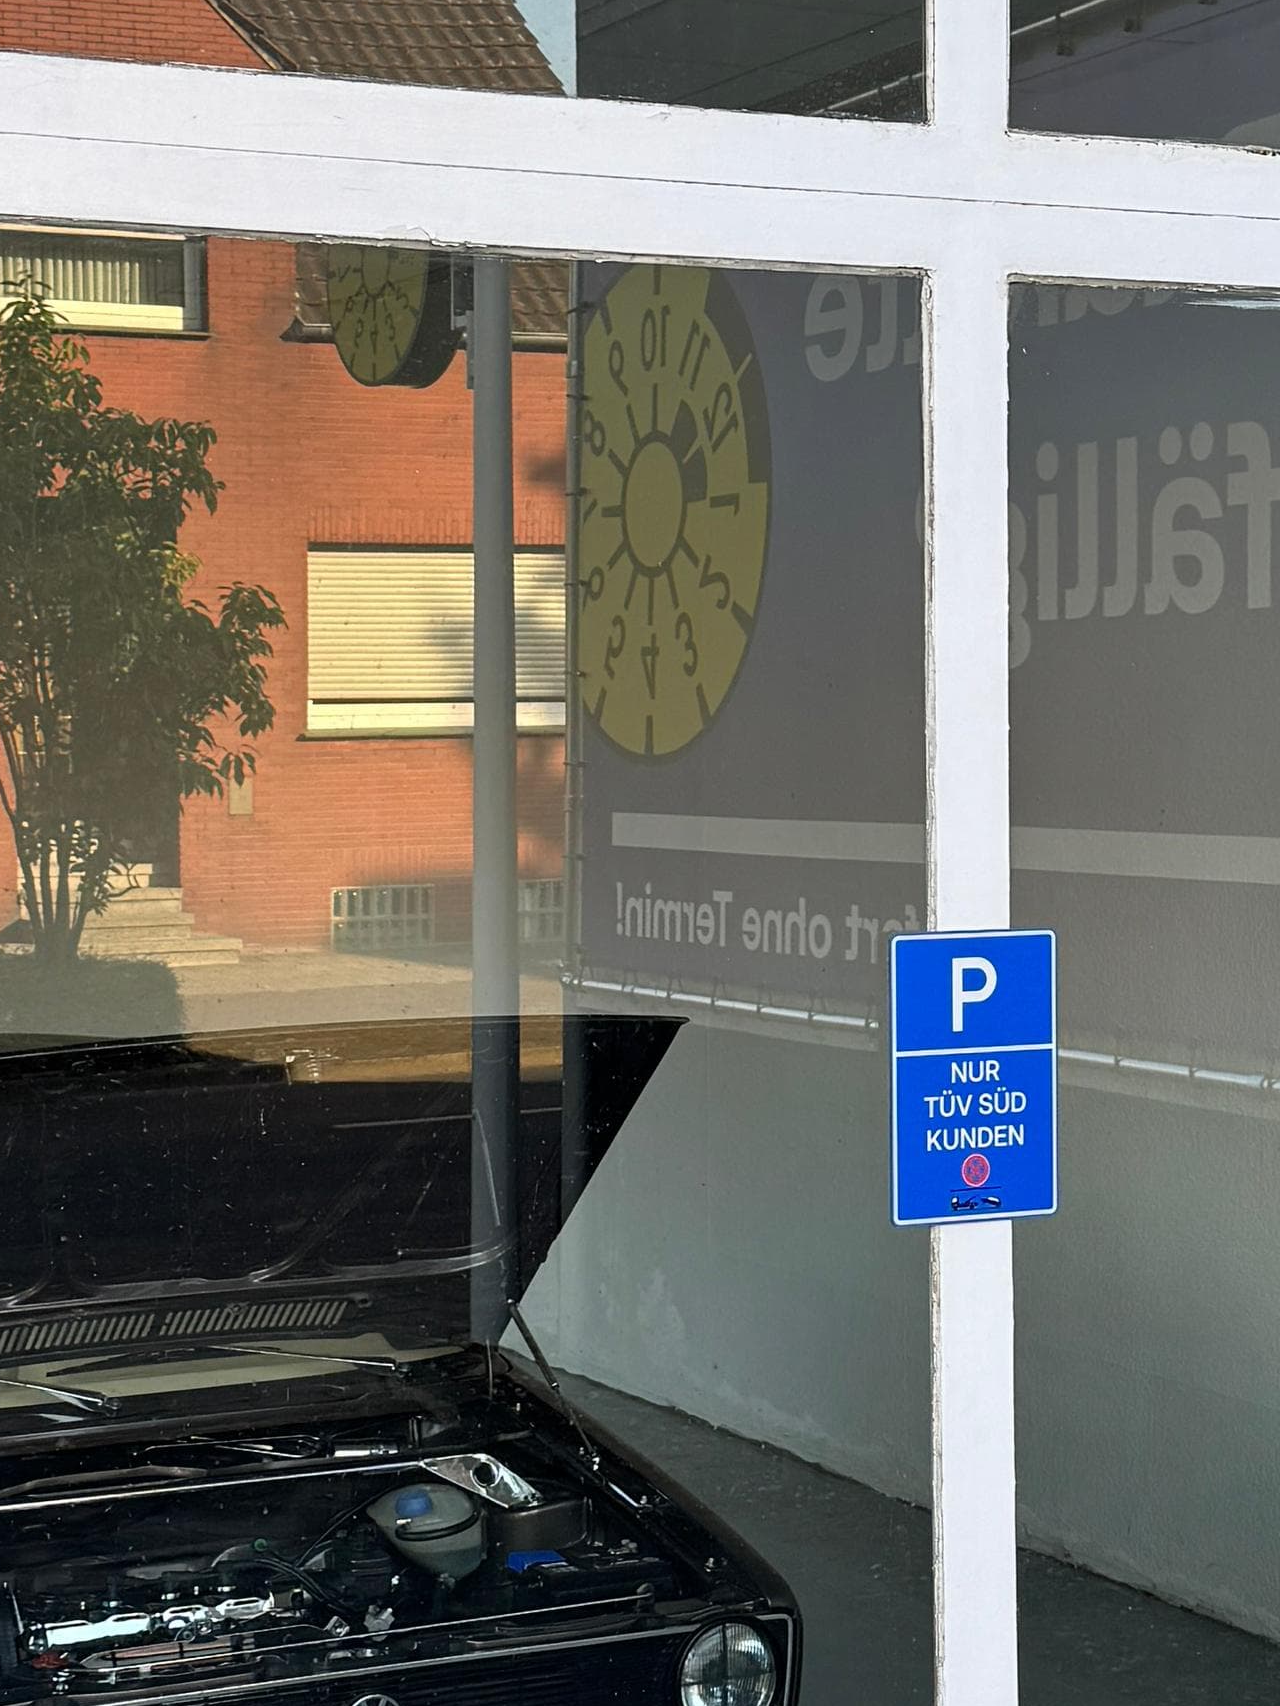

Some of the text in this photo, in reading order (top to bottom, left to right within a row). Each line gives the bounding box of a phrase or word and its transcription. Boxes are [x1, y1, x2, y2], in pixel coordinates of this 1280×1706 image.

[952, 956, 997, 1032] P
[951, 1060, 1000, 1084] NUR
[924, 1086, 1027, 1118] TÜV SÜD
[927, 1124, 1025, 1151] KUNDEN
